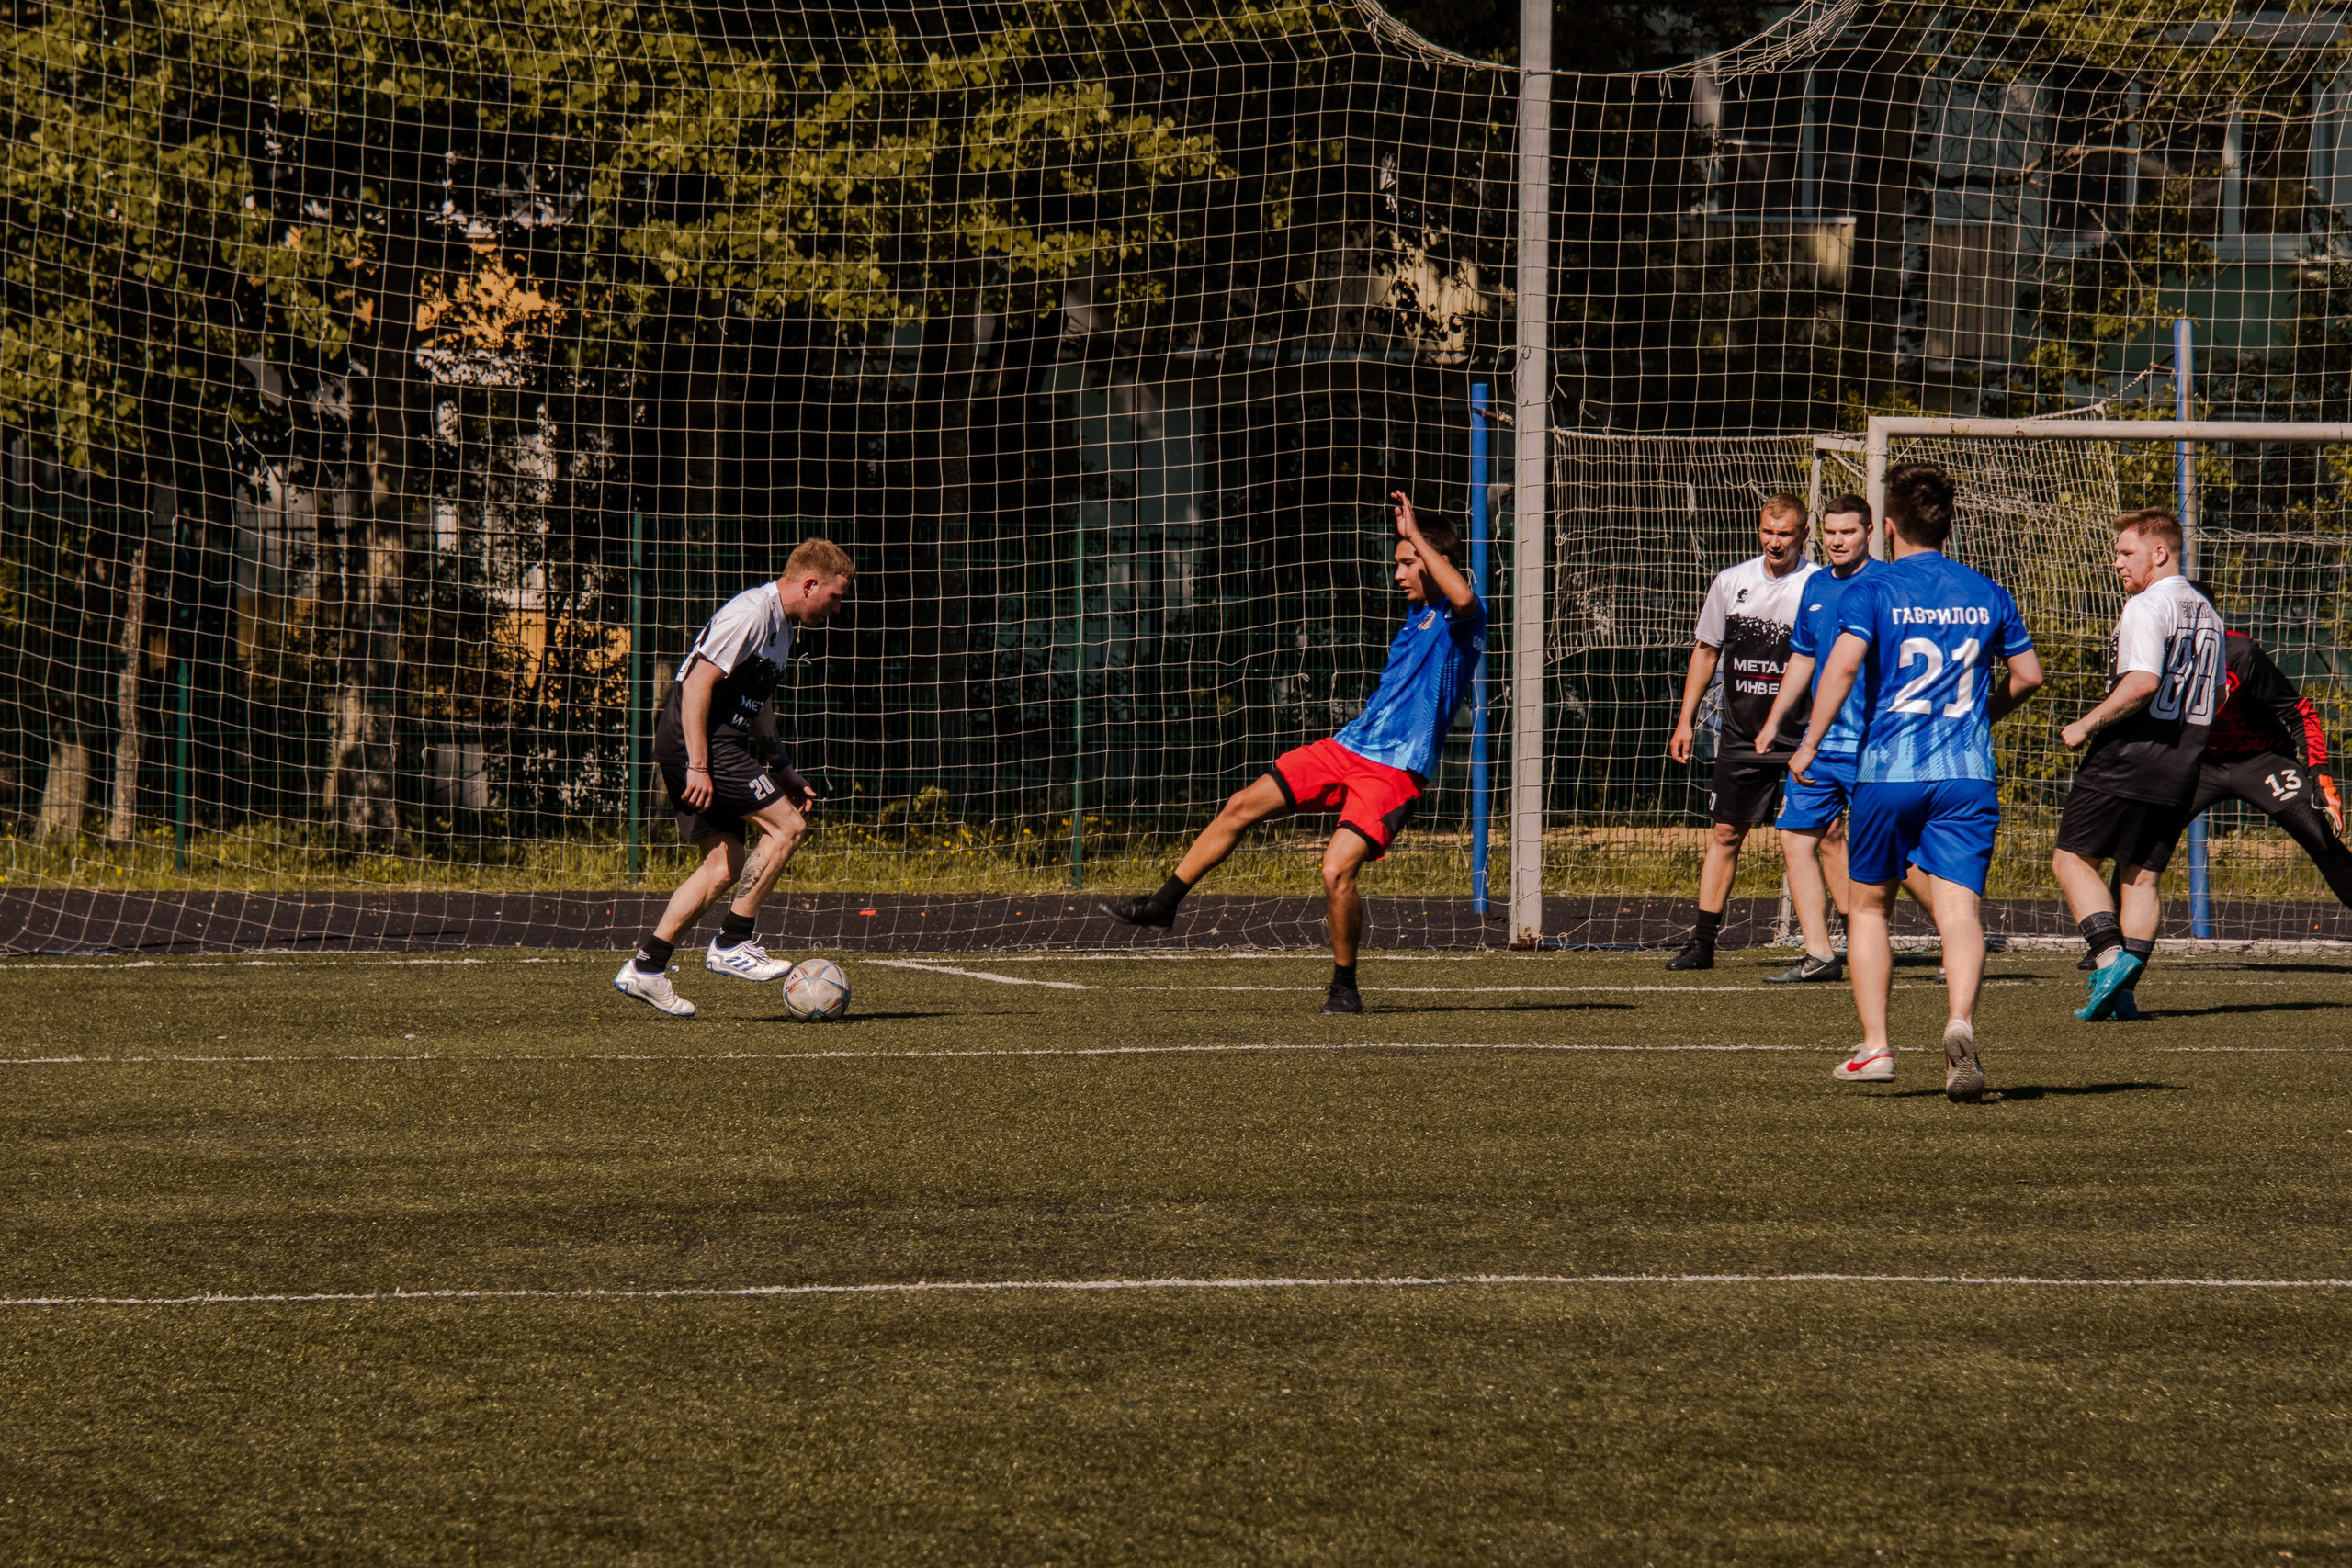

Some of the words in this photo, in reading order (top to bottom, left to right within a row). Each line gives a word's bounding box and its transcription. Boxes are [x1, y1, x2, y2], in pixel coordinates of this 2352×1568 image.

[1892, 606, 1991, 625] ГАВРИЛОВ
[1886, 637, 1980, 718] 21
[749, 773, 775, 800] 20
[2264, 769, 2302, 798] 13
